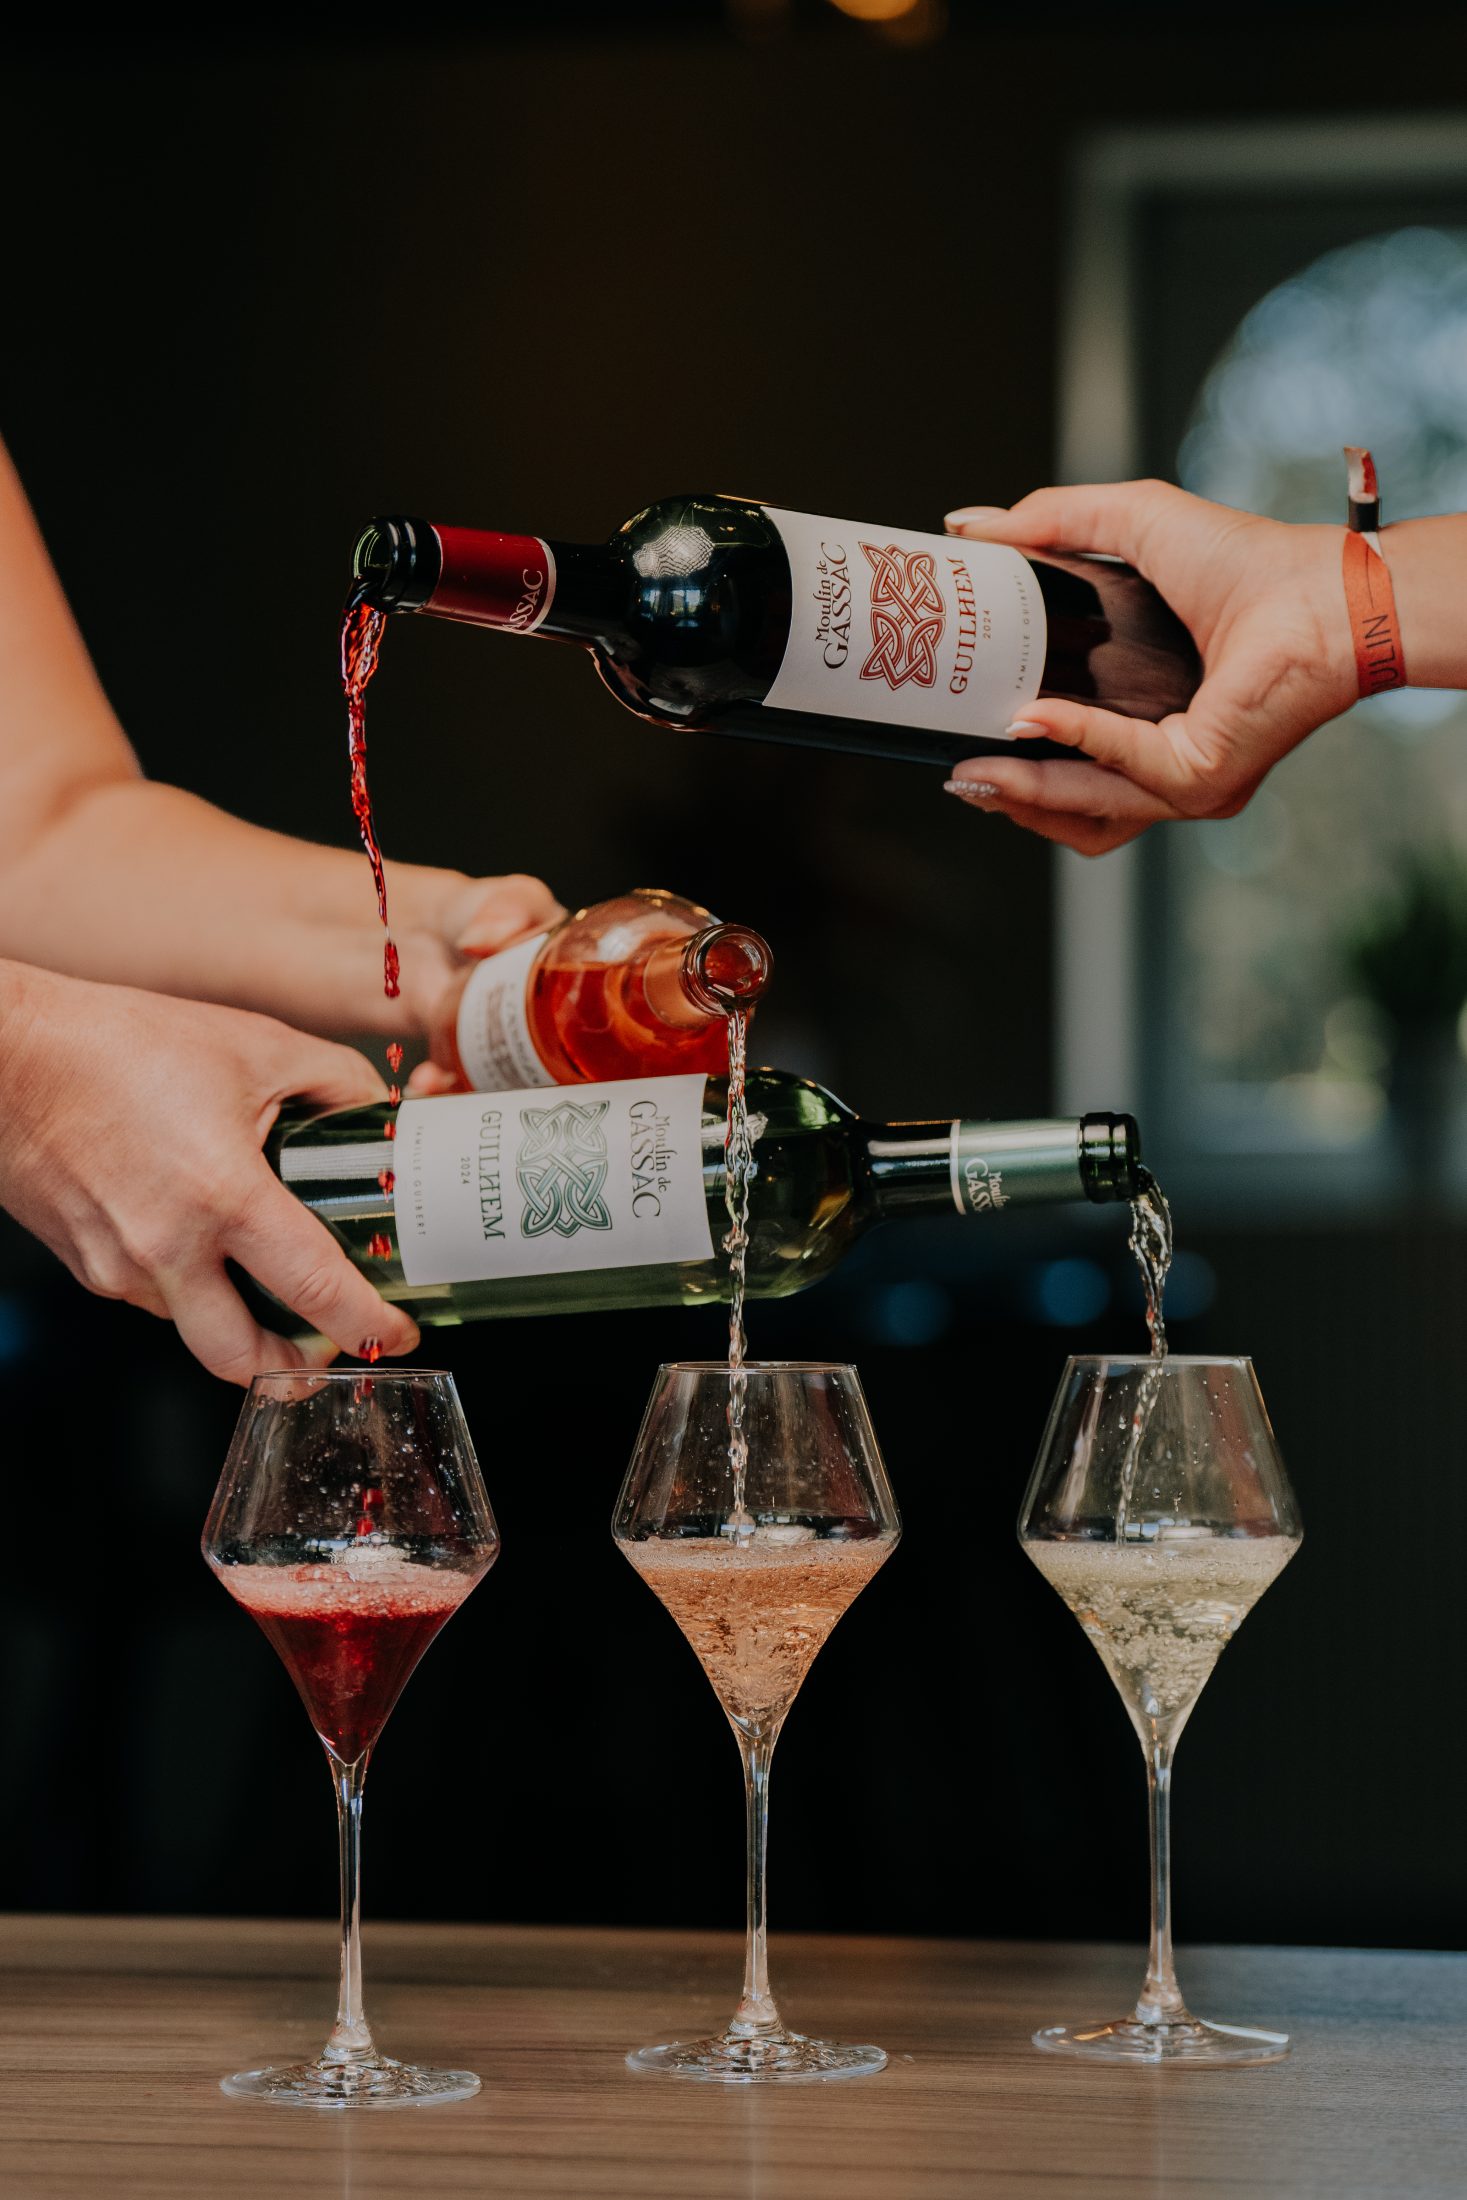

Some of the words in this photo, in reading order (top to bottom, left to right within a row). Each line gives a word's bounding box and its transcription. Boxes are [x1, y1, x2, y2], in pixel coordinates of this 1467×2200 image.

[816, 559, 829, 575] de
[812, 579, 832, 643] Moulin
[821, 542, 852, 669] GASSAC
[947, 556, 976, 694] GUILHEM
[982, 608, 992, 640] 2024
[1015, 632, 1032, 690] FAMILLE
[412, 1125, 425, 1172] FAMILLE
[460, 1156, 470, 1185] 2024
[628, 1100, 662, 1219] GASSAC
[655, 1115, 678, 1171] Moulin
[478, 1109, 506, 1241] GUILHEM
[657, 1176, 671, 1193] de
[965, 1157, 993, 1212] GASS
[412, 1179, 427, 1237] GUIBERT
